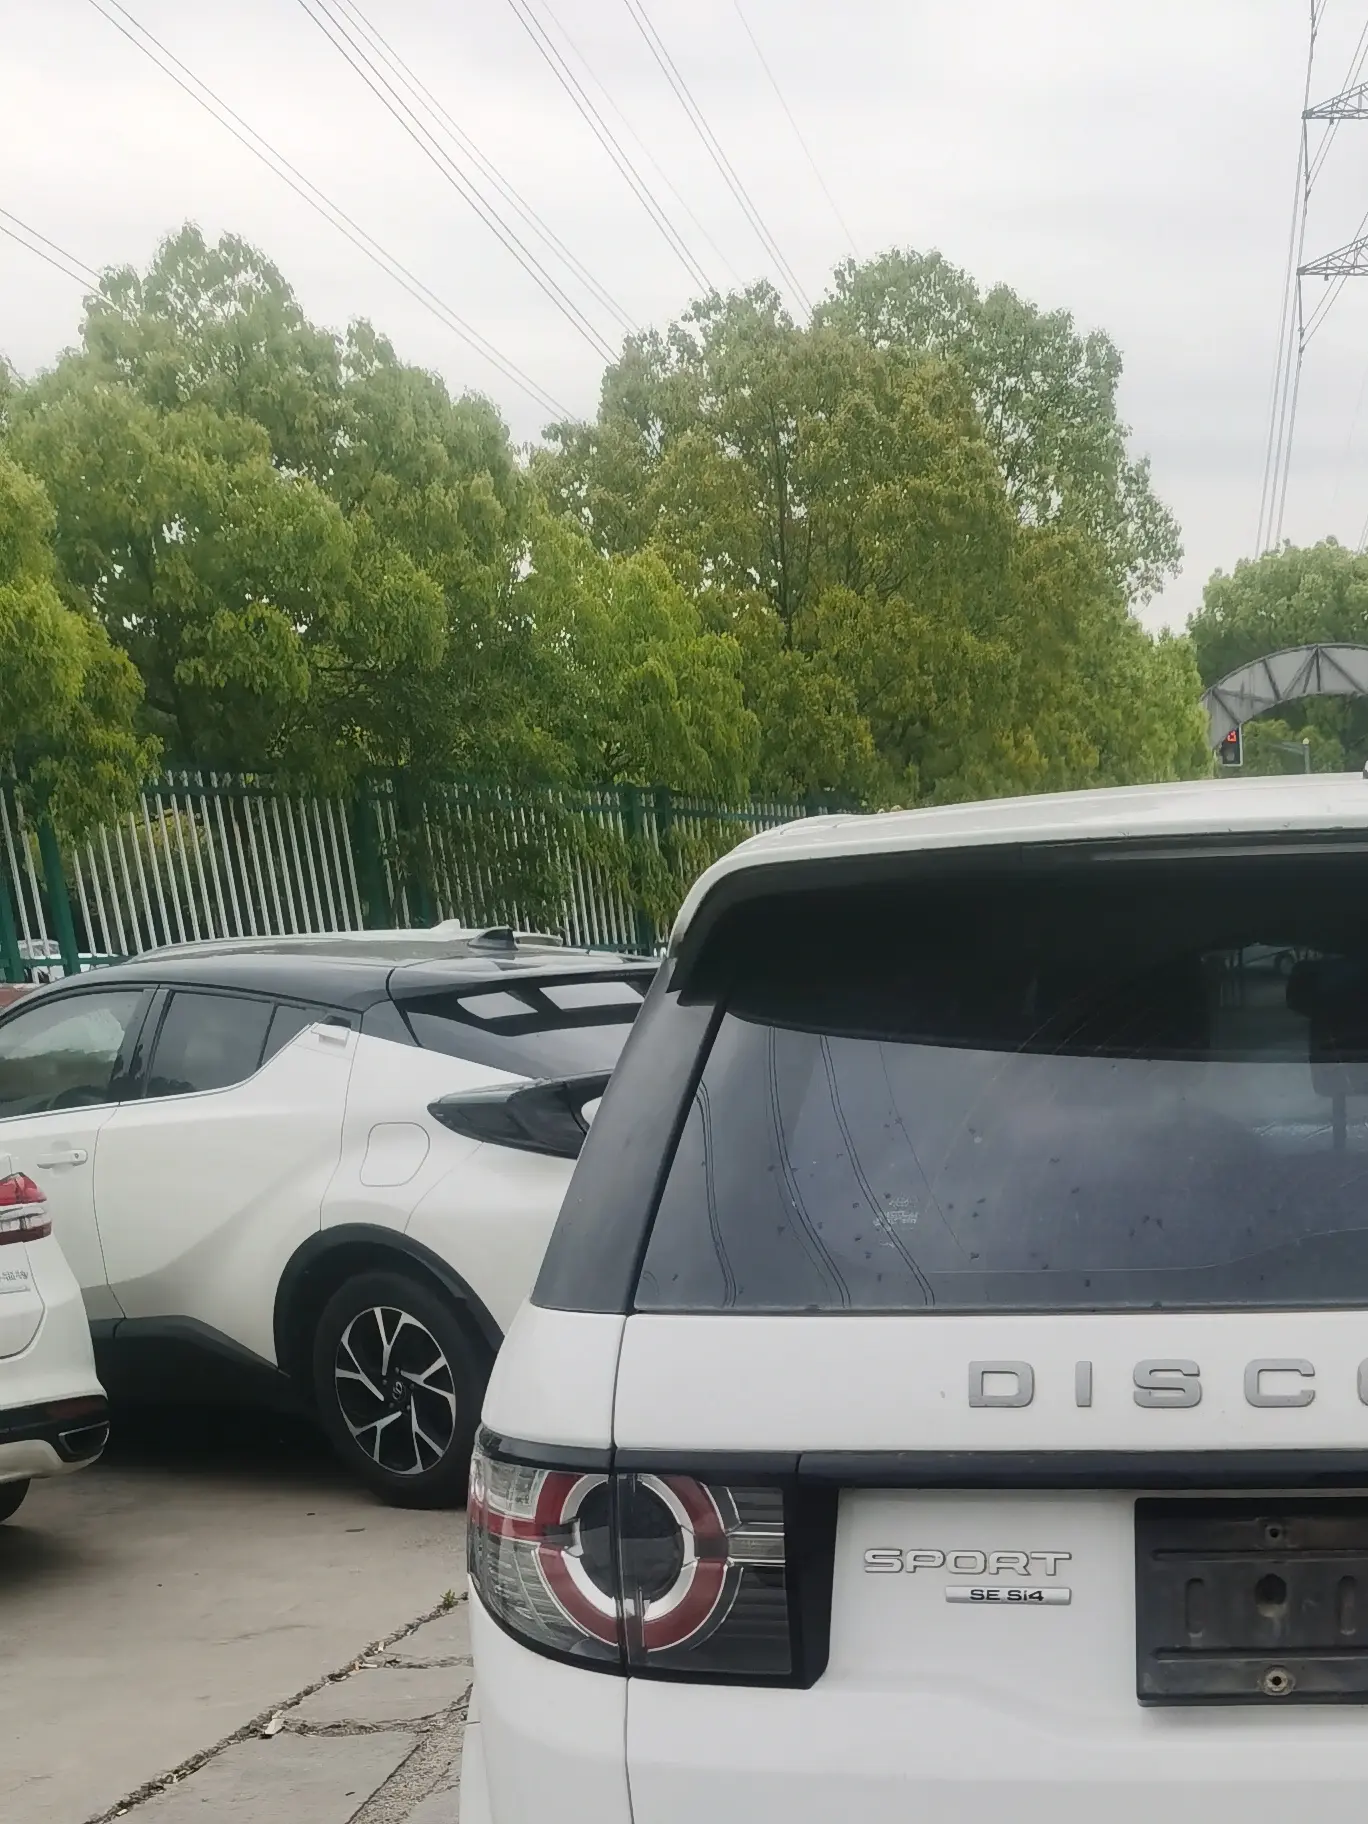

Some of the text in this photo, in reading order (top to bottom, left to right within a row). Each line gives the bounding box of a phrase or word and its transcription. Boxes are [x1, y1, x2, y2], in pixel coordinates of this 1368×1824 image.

[864, 1549, 1072, 1576] SPORT
[970, 1589, 1044, 1602] SE Si4
